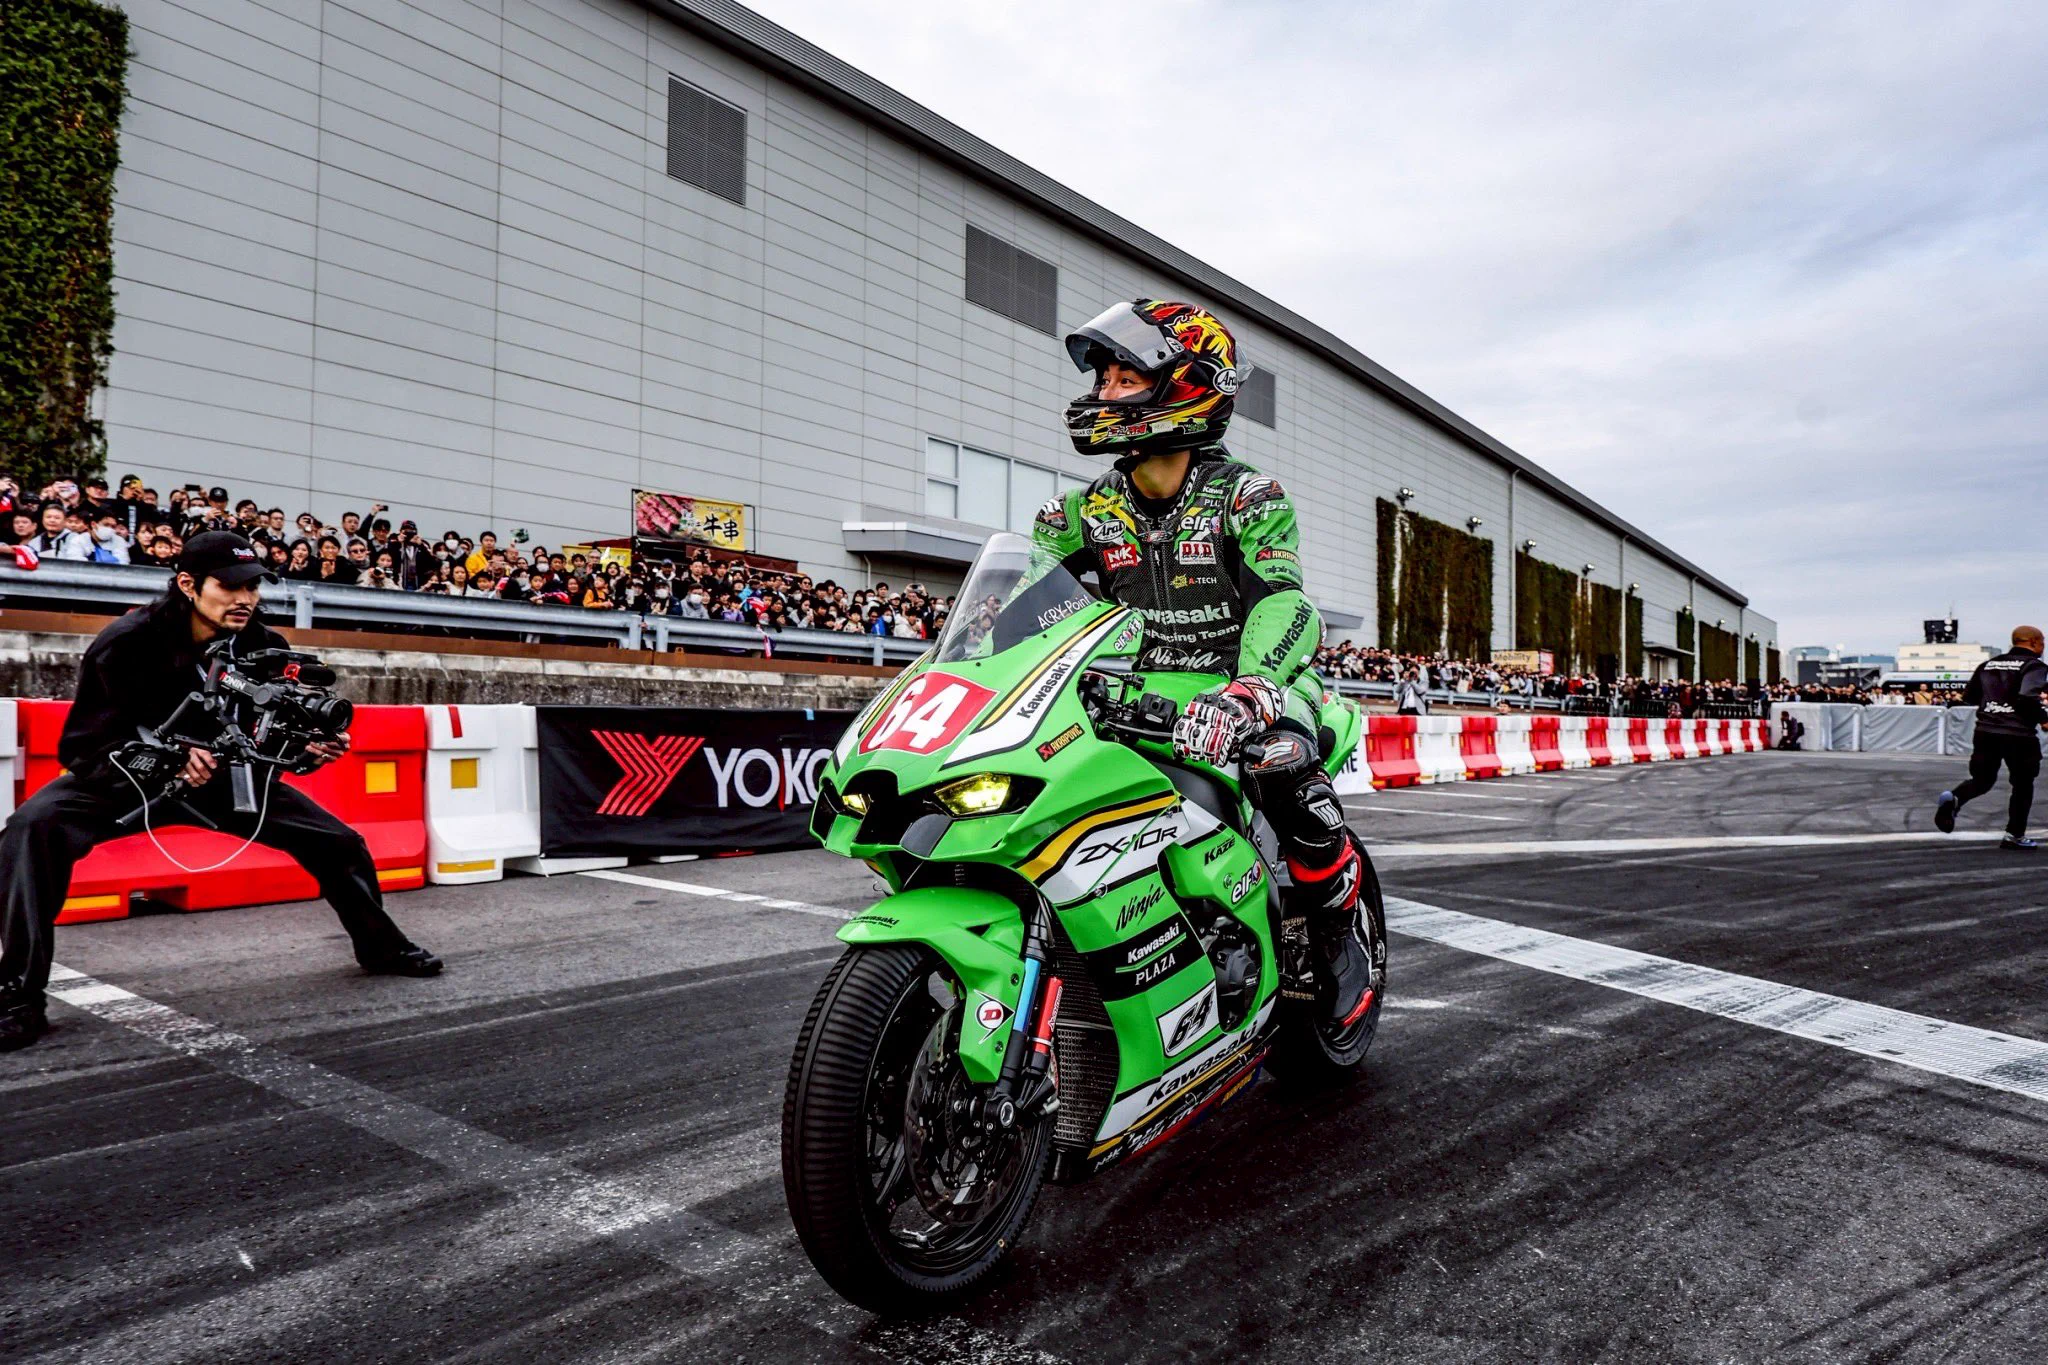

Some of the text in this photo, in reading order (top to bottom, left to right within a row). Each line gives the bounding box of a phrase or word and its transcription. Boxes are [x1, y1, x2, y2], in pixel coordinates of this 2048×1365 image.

[703, 513, 739, 543] 牛串
[1098, 523, 1124, 538] Arai
[1180, 516, 1211, 530] elf
[1188, 577, 1217, 585] A-TECH
[1037, 594, 1091, 630] ACRY-Point
[1132, 602, 1231, 625] wasaki
[1198, 624, 1240, 640] Team
[1260, 599, 1314, 672] Kawasaki
[1493, 652, 1531, 663] Mobility
[1017, 662, 1071, 718] Kawasaki
[867, 678, 970, 749] 64
[1074, 826, 1179, 866] ZX-10R
[1204, 837, 1236, 866] KAZE
[1233, 869, 1252, 903] elf
[1115, 884, 1165, 932] Ninja
[1127, 923, 1180, 963] Kawasaki
[1135, 952, 1176, 986] PLAZA
[983, 1008, 1001, 1021] D
[1166, 985, 1216, 1052] 64
[1145, 1021, 1258, 1107] Kawasaki
